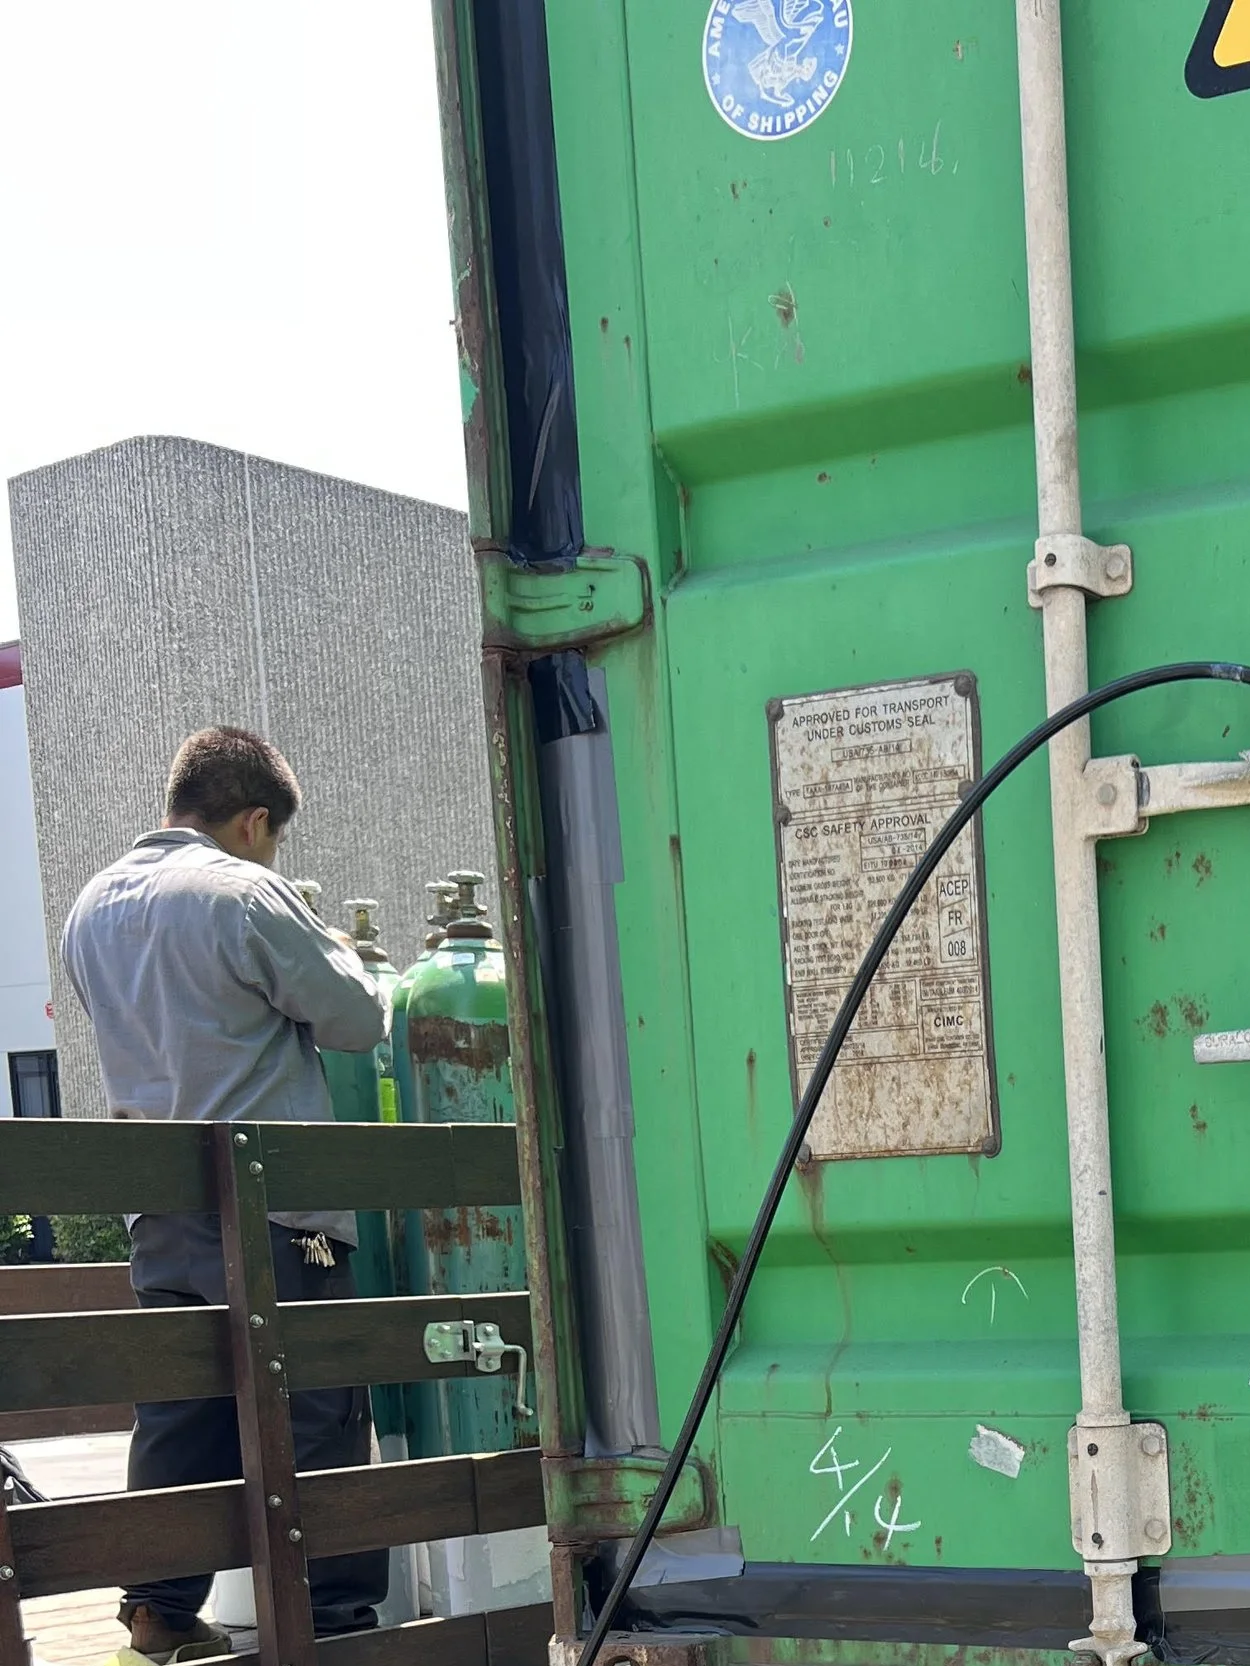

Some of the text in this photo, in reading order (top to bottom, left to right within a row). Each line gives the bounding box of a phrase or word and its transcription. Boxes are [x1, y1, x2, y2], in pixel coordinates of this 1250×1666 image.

[721, 70, 840, 133] OF SHIPPING
[792, 695, 950, 728] APPROVED FOR TRANSPORT
[807, 714, 935, 742] UNDER CUSTOMS SEAL
[795, 813, 931, 839] CSC SAFETY APPROVAL
[938, 880, 969, 896] ACEP
[948, 910, 962, 926] FR
[948, 940, 966, 957] 008
[934, 1015, 964, 1027] CIMC
